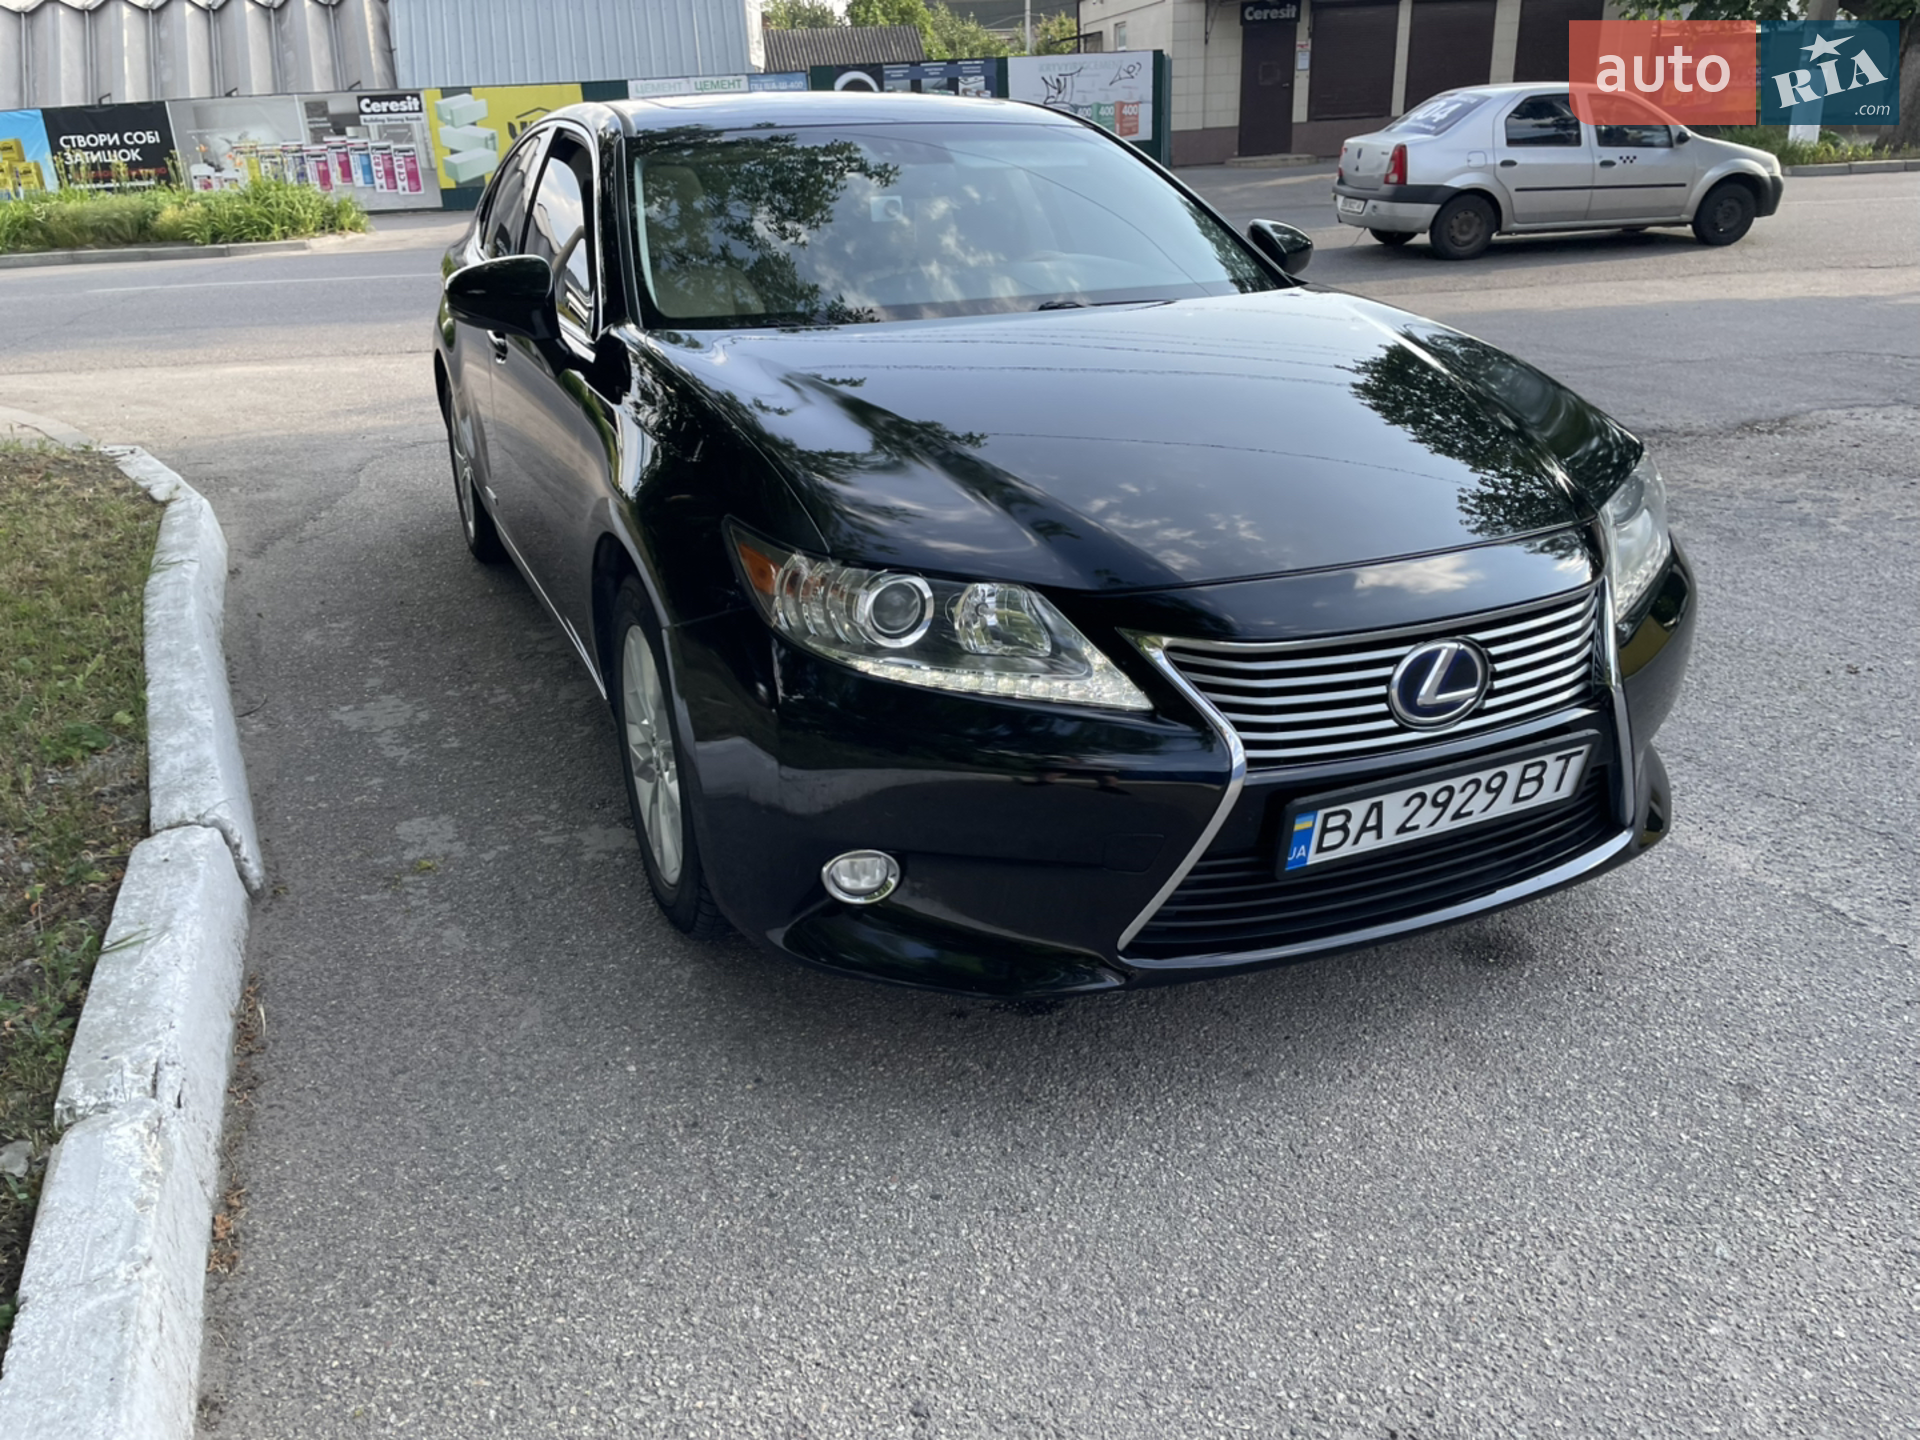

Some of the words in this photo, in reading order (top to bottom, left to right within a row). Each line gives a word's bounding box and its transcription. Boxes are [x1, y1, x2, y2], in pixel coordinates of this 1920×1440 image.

[1244, 4, 1297, 21] Ceresit
[635, 82, 682, 95] ЦЕМЕНТ
[694, 79, 743, 92] ЦЕМЕНТ
[359, 95, 420, 113] Ceresit
[1098, 106, 1114, 116] 400
[1122, 104, 1138, 116] 400
[59, 132, 120, 148] СТВОРИ
[123, 130, 161, 145] СОБІ
[64, 148, 143, 165] ЗАТИШОК
[1315, 800, 1385, 855] BA
[1395, 770, 1509, 837] 2929
[1511, 749, 1587, 804] BT
